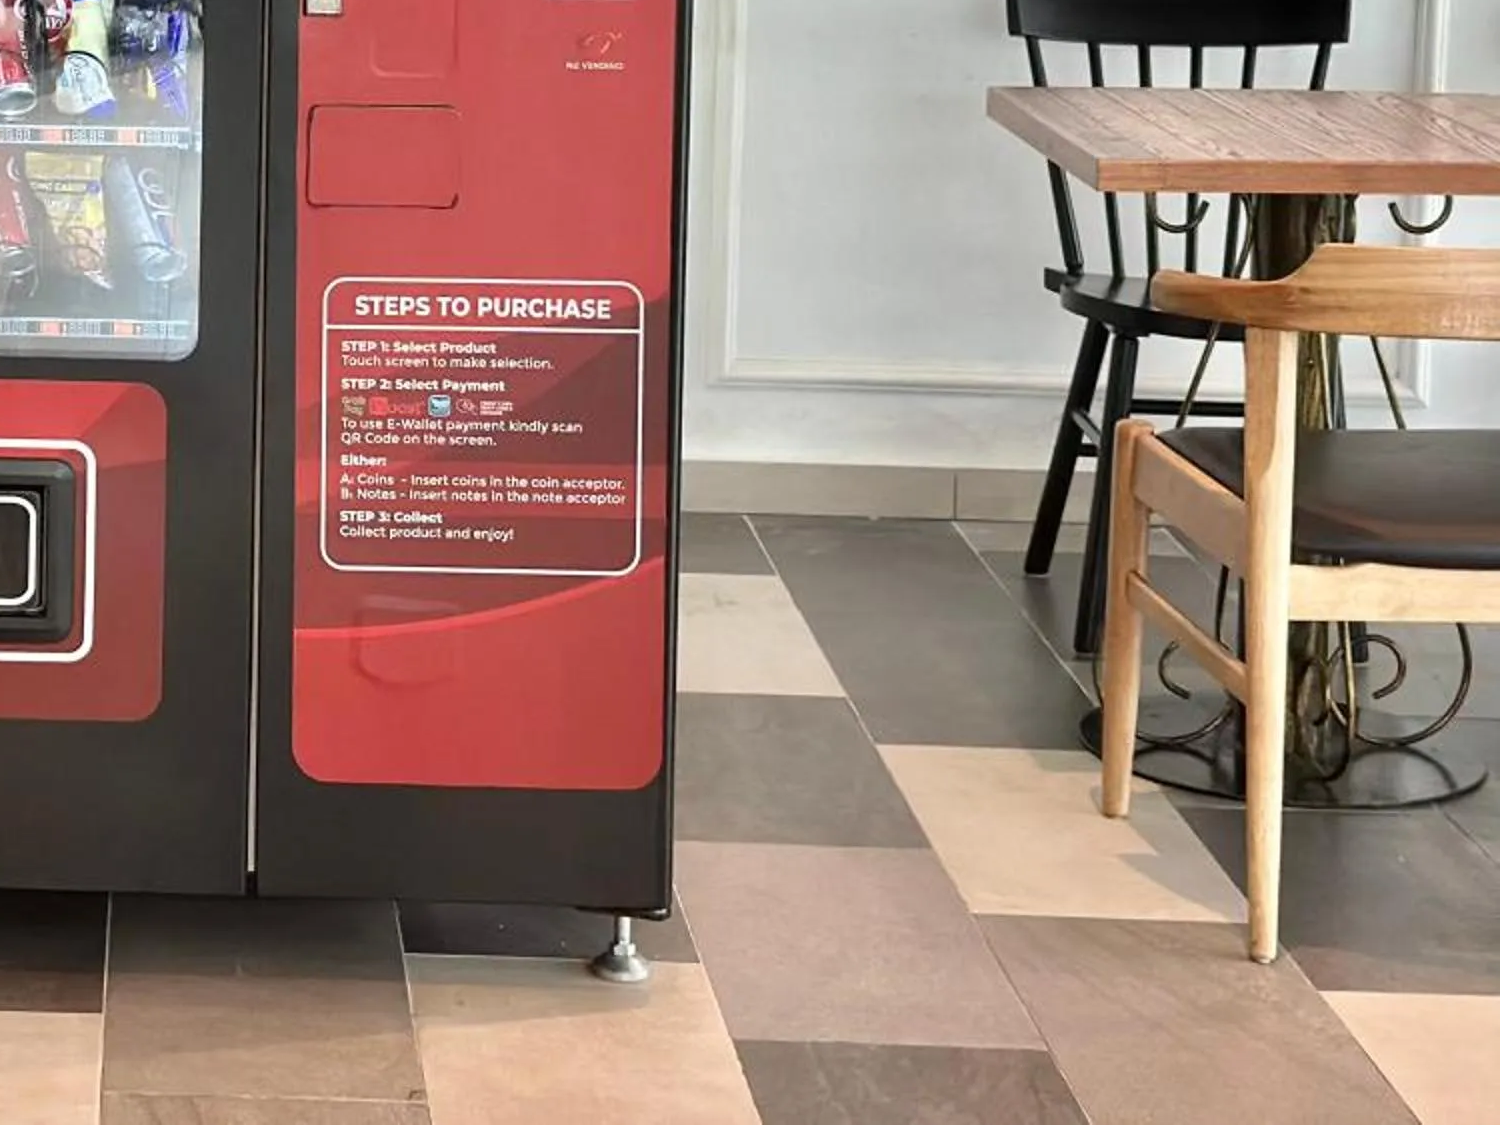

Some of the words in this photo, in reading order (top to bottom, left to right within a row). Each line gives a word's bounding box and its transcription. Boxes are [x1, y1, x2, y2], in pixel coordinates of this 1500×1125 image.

[355, 295, 430, 317] STEPS
[436, 297, 470, 318] TO
[477, 297, 612, 320] PURCHASE
[341, 340, 377, 353] STEP
[393, 341, 437, 354] Select
[440, 342, 496, 355] Product
[341, 355, 381, 367] Touch
[385, 357, 428, 369] screen
[432, 357, 447, 369] to
[450, 356, 486, 369] make
[490, 357, 554, 370] selection.
[341, 378, 376, 391] STEP
[395, 379, 438, 391] Select
[442, 380, 505, 394] Payment
[341, 418, 358, 429] To
[360, 420, 383, 430] use
[387, 418, 442, 431] E-Wallet
[446, 421, 505, 434] payment
[509, 420, 548, 434] kindly
[552, 422, 583, 434] scan
[341, 432, 361, 445] QR
[364, 432, 400, 445] Code
[403, 434, 420, 445] on
[424, 433, 446, 445] the
[449, 435, 497, 446] screen.
[340, 453, 387, 466] Either:
[357, 473, 395, 485] Coins
[411, 474, 449, 487] Insert
[452, 475, 486, 487] coins
[490, 475, 502, 488] in
[506, 476, 528, 488] the
[531, 476, 560, 489] coin
[563, 478, 625, 492] acceptor.
[357, 488, 397, 500] Notes
[410, 489, 447, 501] Insert
[451, 490, 488, 502] notes
[492, 490, 503, 502] in
[507, 491, 529, 503] the
[532, 492, 563, 504] note
[566, 493, 626, 506] acceptor
[340, 510, 376, 523] STEP
[394, 511, 443, 524] Collect
[340, 525, 386, 538] Collect
[390, 526, 441, 540] product
[445, 527, 471, 540] and
[474, 528, 514, 543] enjoy!
